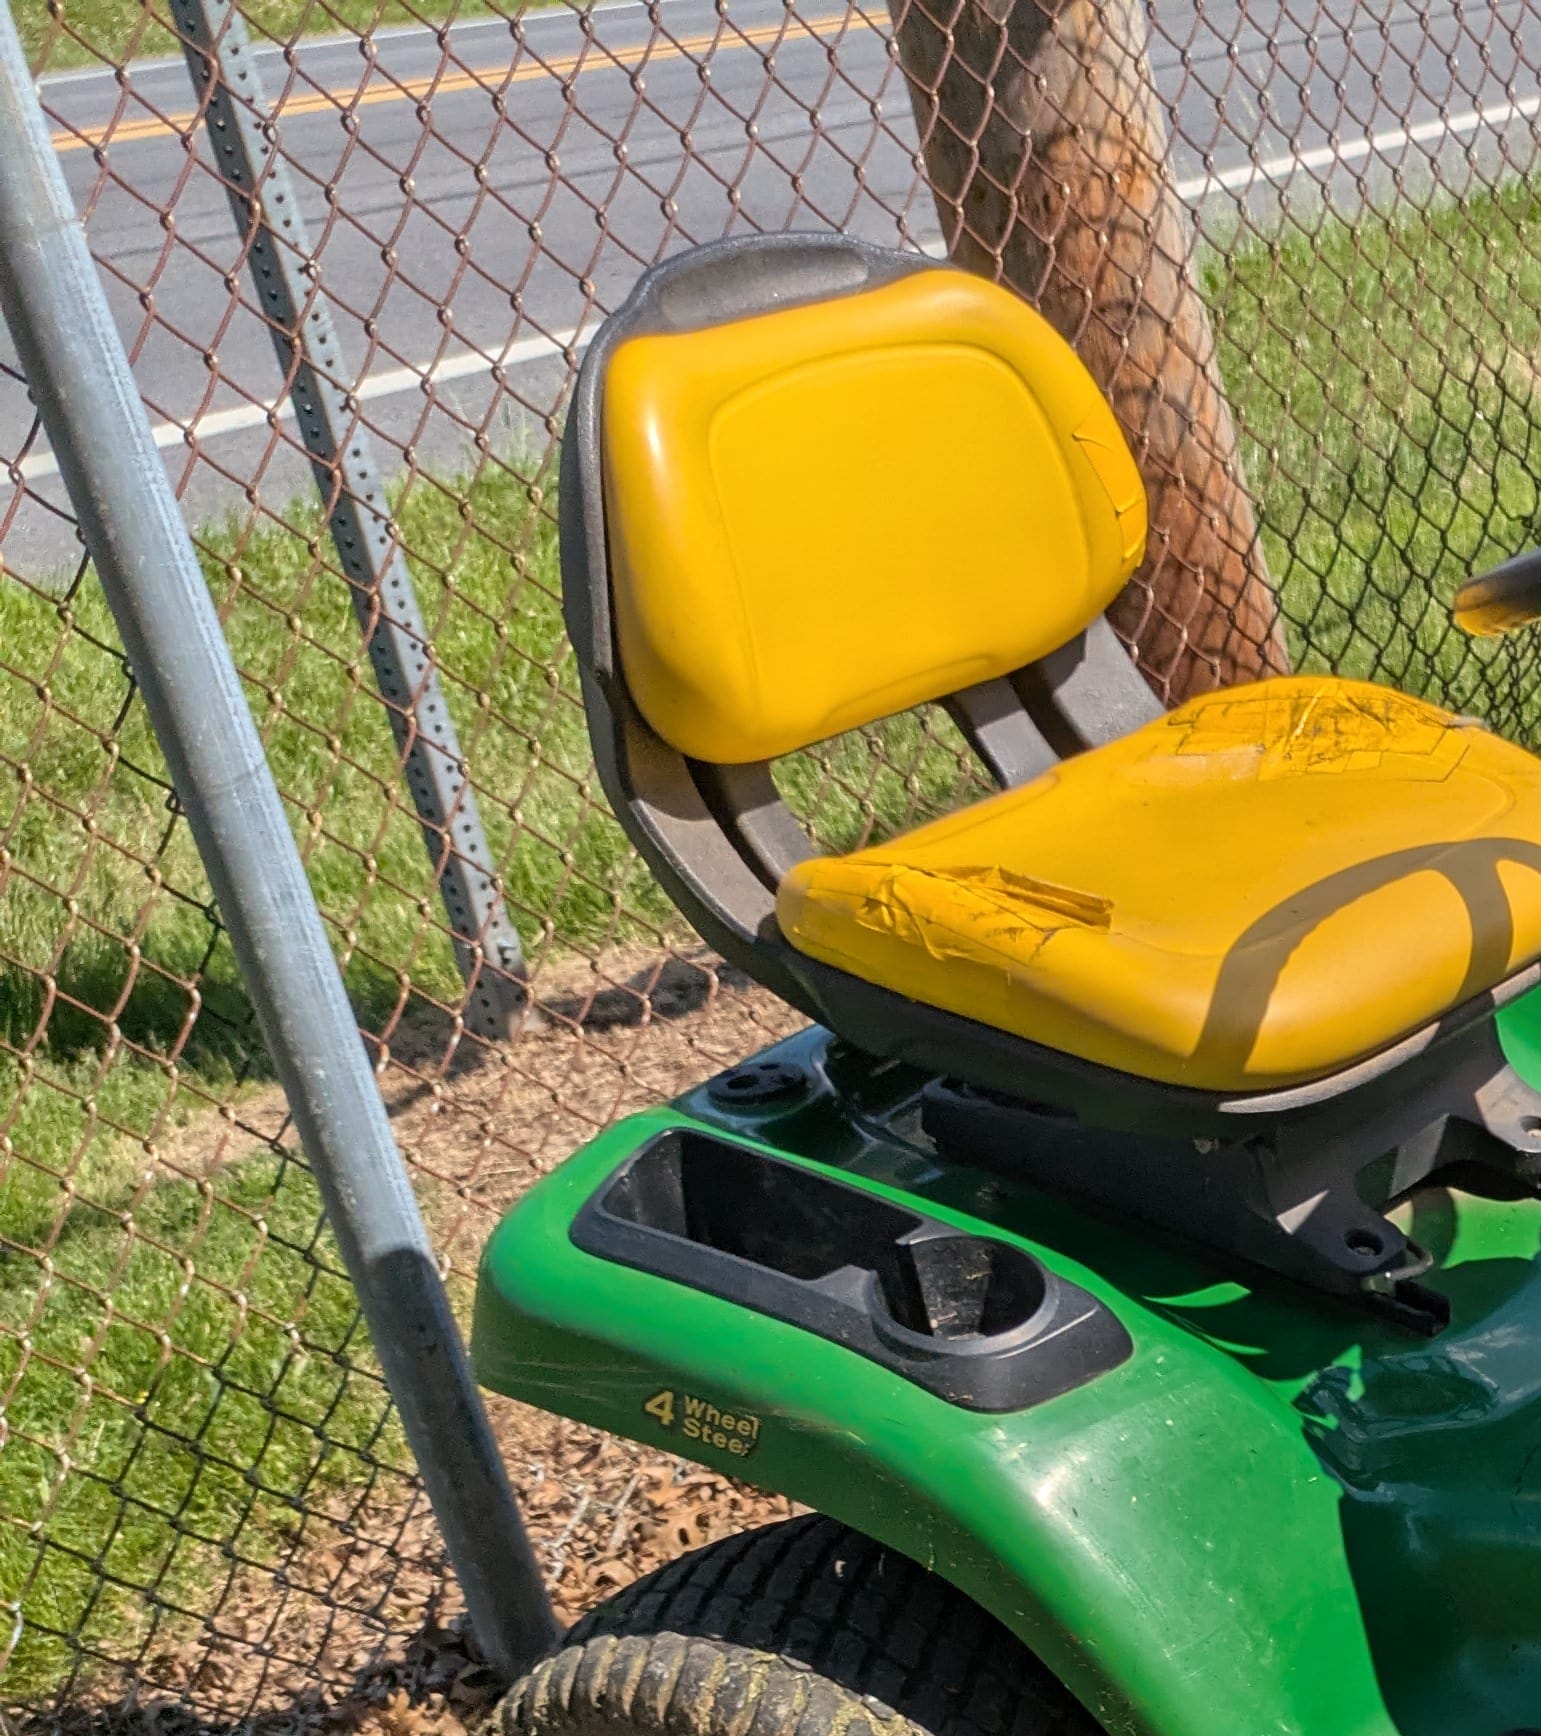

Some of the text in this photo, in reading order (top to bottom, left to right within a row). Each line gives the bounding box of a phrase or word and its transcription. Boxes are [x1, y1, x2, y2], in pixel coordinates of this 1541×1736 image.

[644, 1390, 675, 1426] 4
[683, 1394, 760, 1440] Wheel
[682, 1416, 752, 1457] Steer
